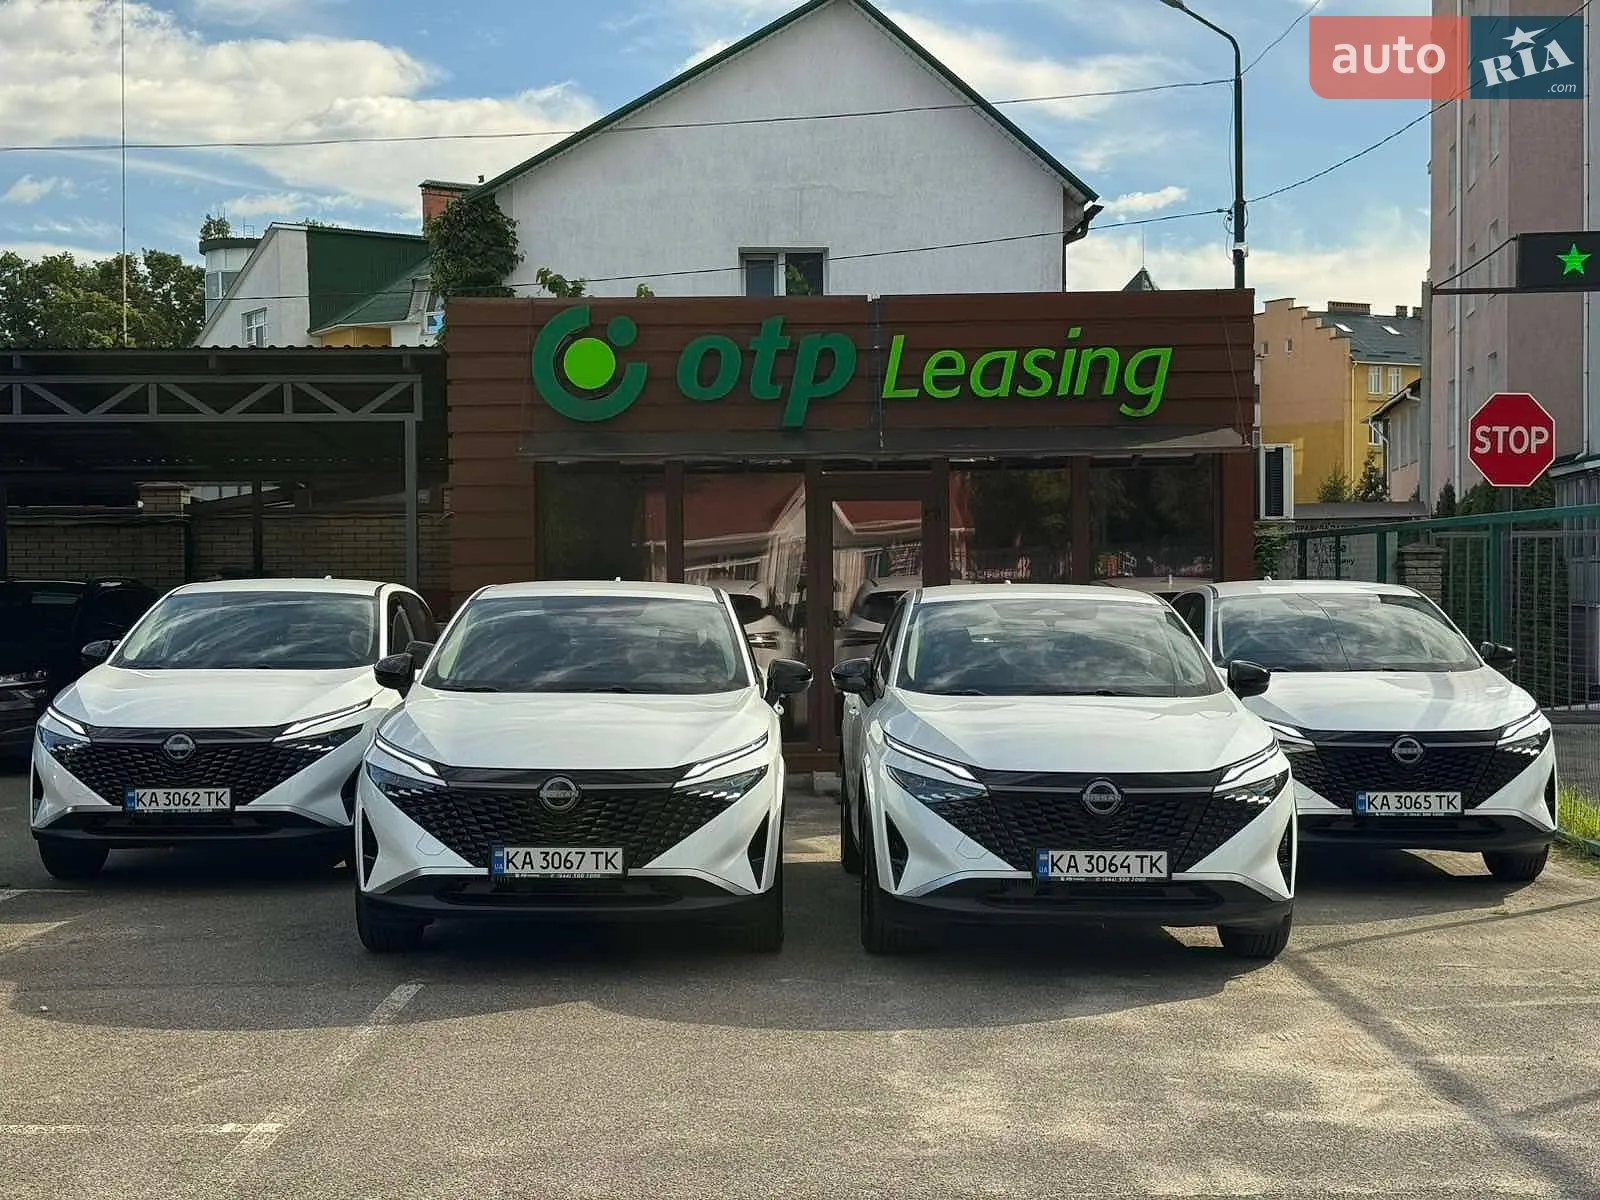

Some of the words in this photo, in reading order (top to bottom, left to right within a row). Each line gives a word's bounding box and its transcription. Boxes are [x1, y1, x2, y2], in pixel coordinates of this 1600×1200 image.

[676, 315, 857, 427] otp
[882, 327, 1173, 417] Leasing
[1474, 425, 1549, 454] STOP
[136, 791, 160, 807] KA
[163, 791, 201, 807] 3062
[204, 791, 226, 807] TK
[1367, 794, 1391, 810] KA
[1394, 794, 1432, 810] 3065
[1435, 794, 1459, 810] TK
[505, 850, 534, 870] KA
[539, 850, 586, 870] 3067
[590, 850, 619, 870] TK
[1050, 854, 1080, 874] KA
[1084, 854, 1131, 874] 3064
[1135, 854, 1164, 874] TK
